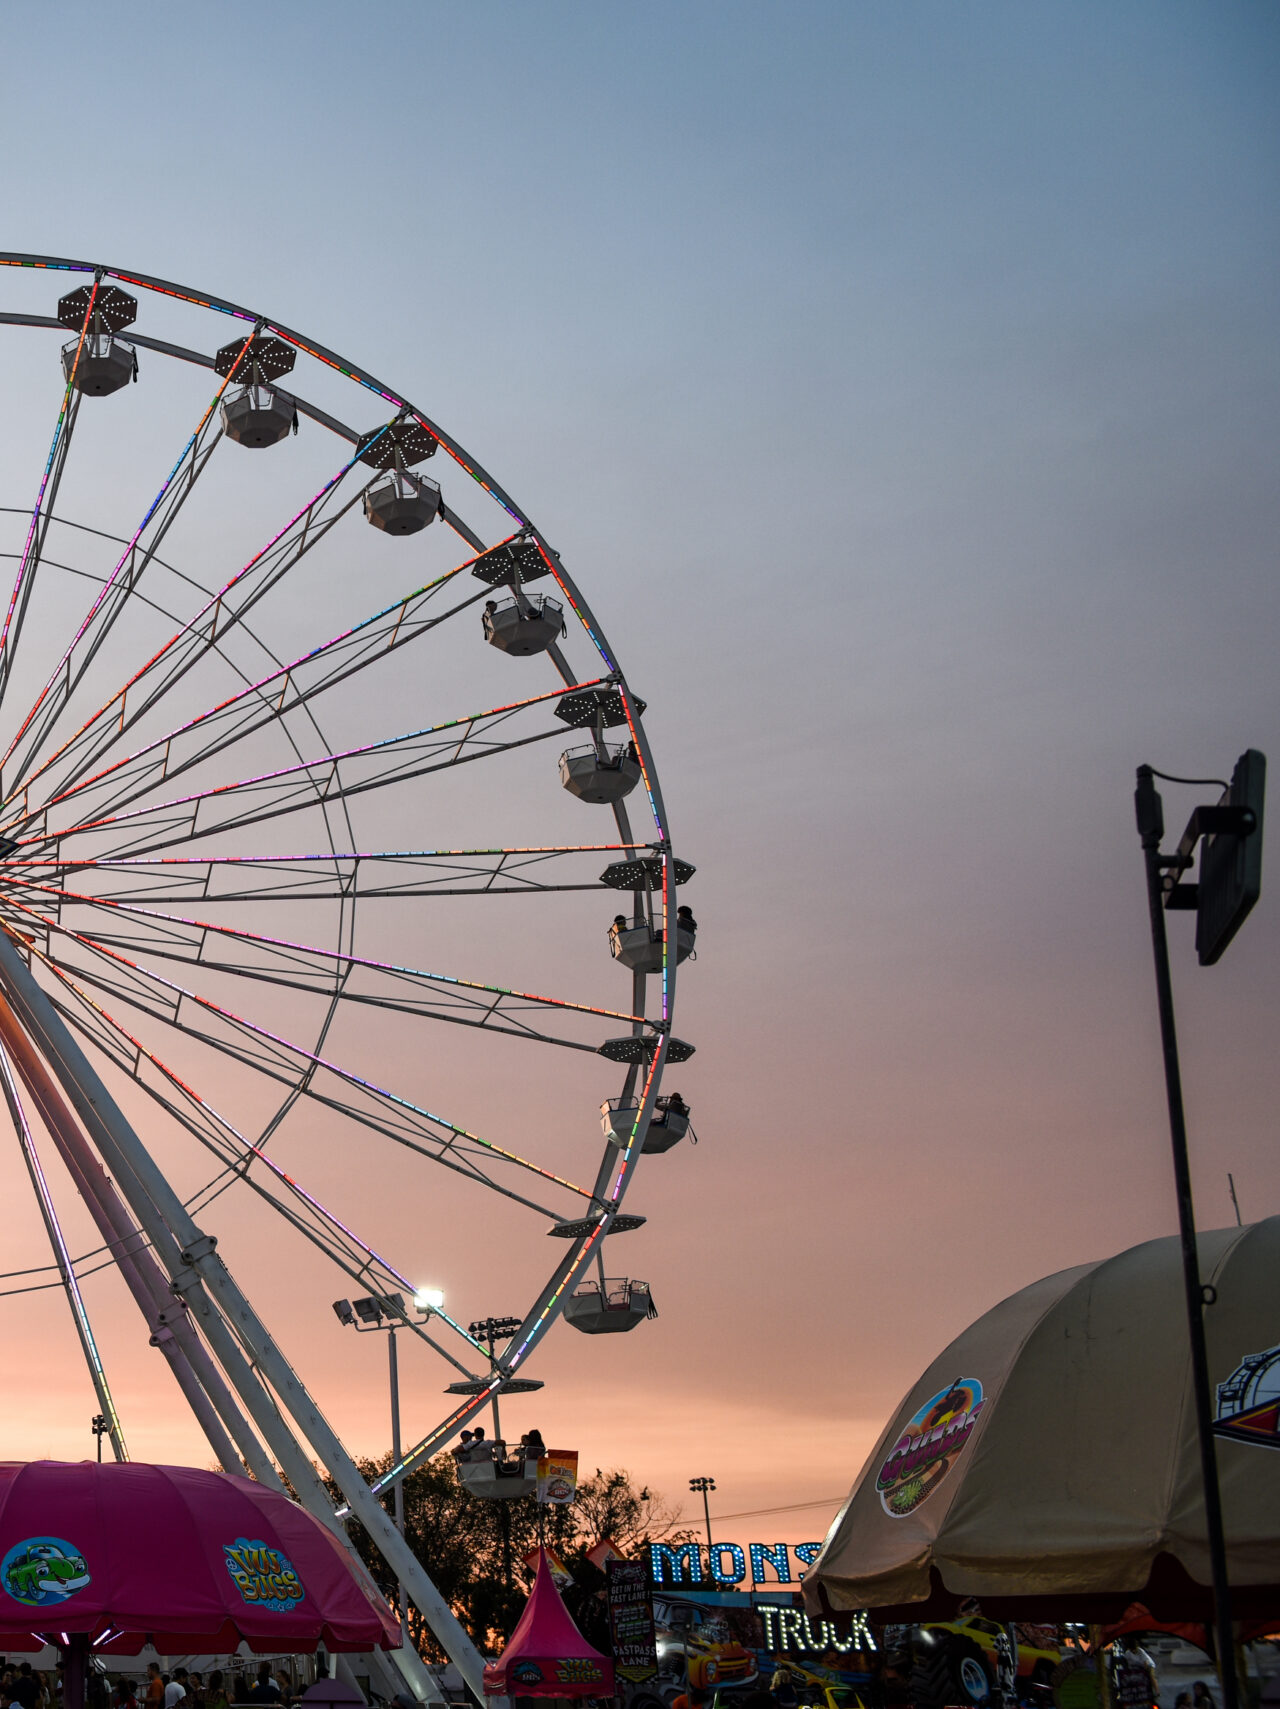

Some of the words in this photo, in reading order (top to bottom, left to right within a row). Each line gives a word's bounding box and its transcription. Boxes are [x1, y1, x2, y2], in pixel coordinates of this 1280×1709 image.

[231, 1570, 304, 1601] BUGS
[611, 1585, 623, 1595] GET
[624, 1584, 632, 1593] IN
[633, 1582, 645, 1591] THE
[610, 1593, 627, 1604] FAST
[756, 1603, 879, 1653] TRUCK
[620, 1656, 651, 1667] LANE
